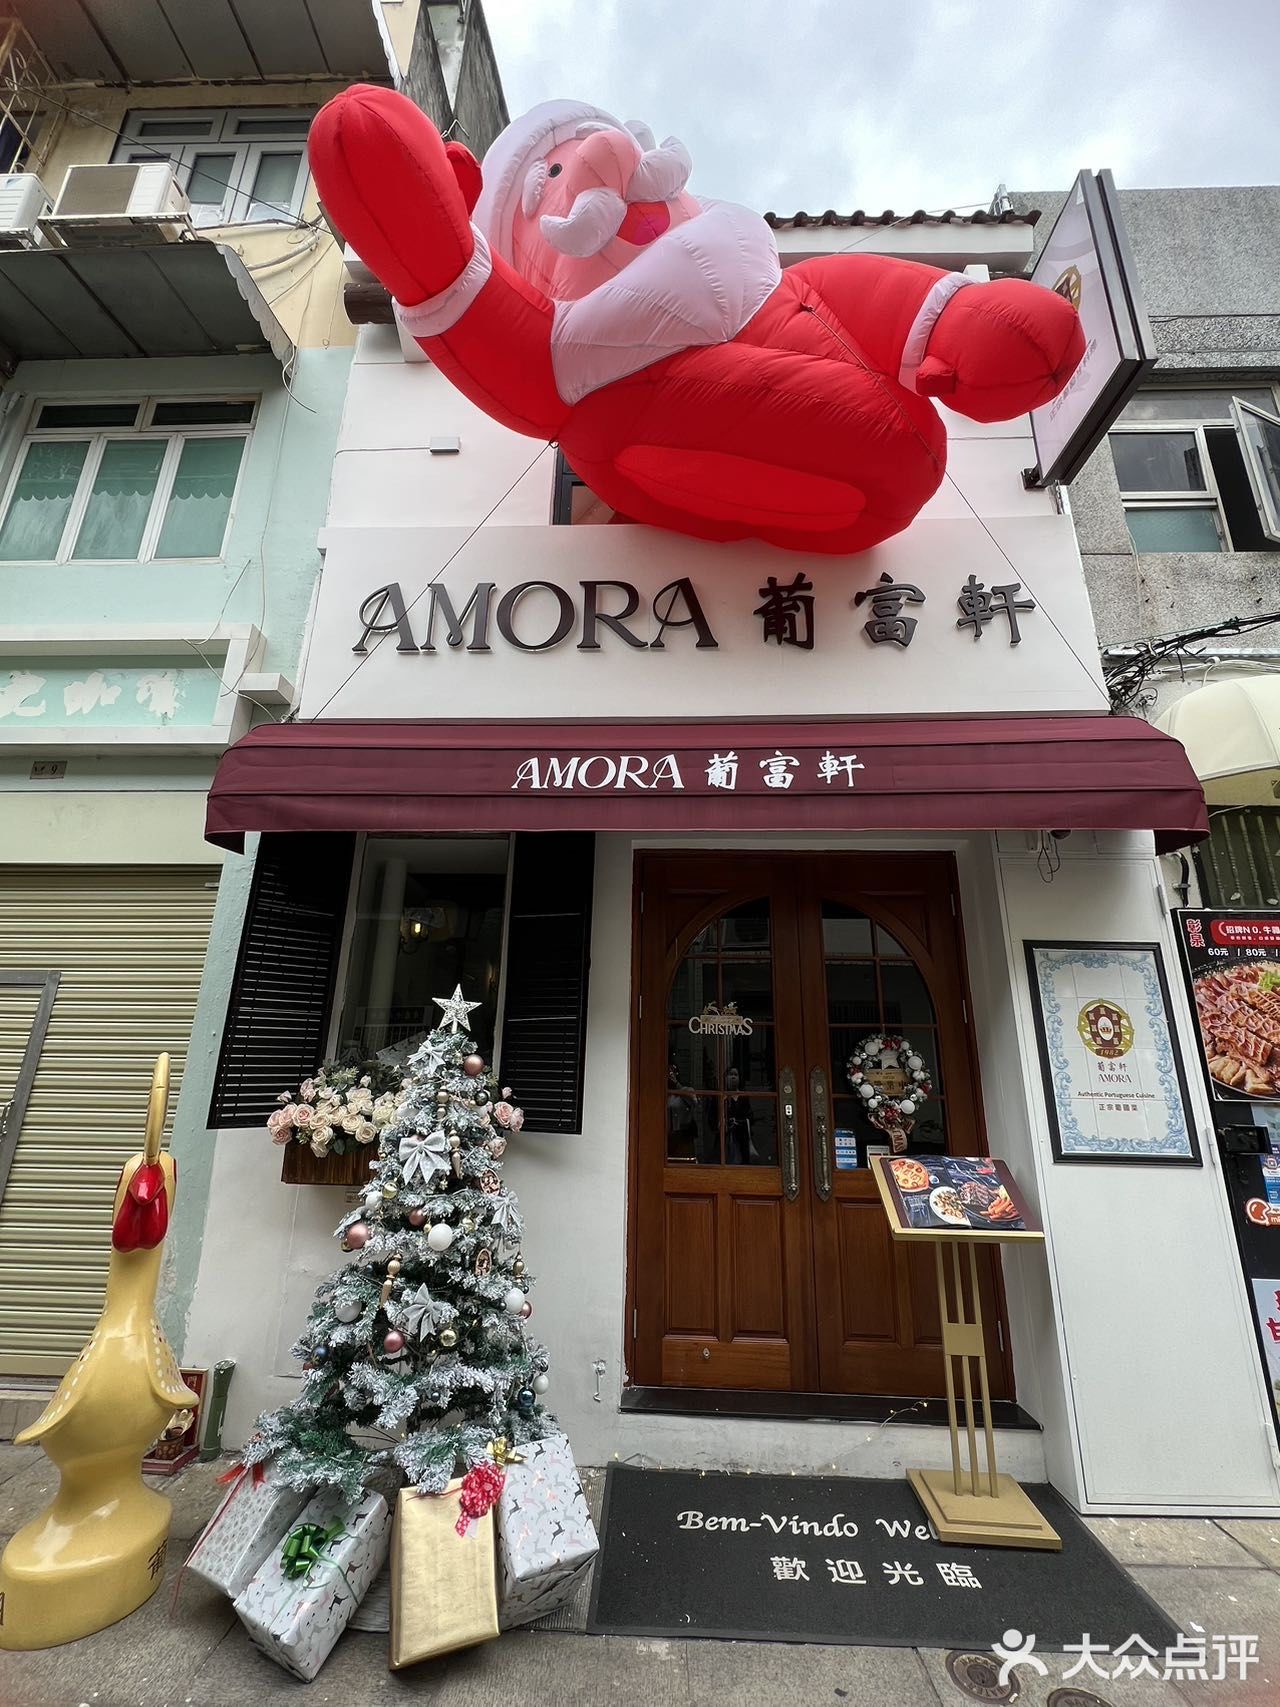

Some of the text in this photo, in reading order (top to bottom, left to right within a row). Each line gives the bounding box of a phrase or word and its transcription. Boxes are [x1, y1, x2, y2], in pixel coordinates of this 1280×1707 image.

[352, 572, 1037, 653] AMORA 葡富軒
[511, 750, 866, 790] AMORA 葡富軒
[1208, 947, 1267, 957] 60元 80元
[688, 1016, 753, 1036] CHRISTMAS
[1098, 1073, 1132, 1083] AMORA
[1077, 1090, 1156, 1100] Authentic Portuguese Cuisine
[677, 1510, 859, 1538] Bem-Vindo
[770, 1557, 983, 1589] 歡迎光臨
